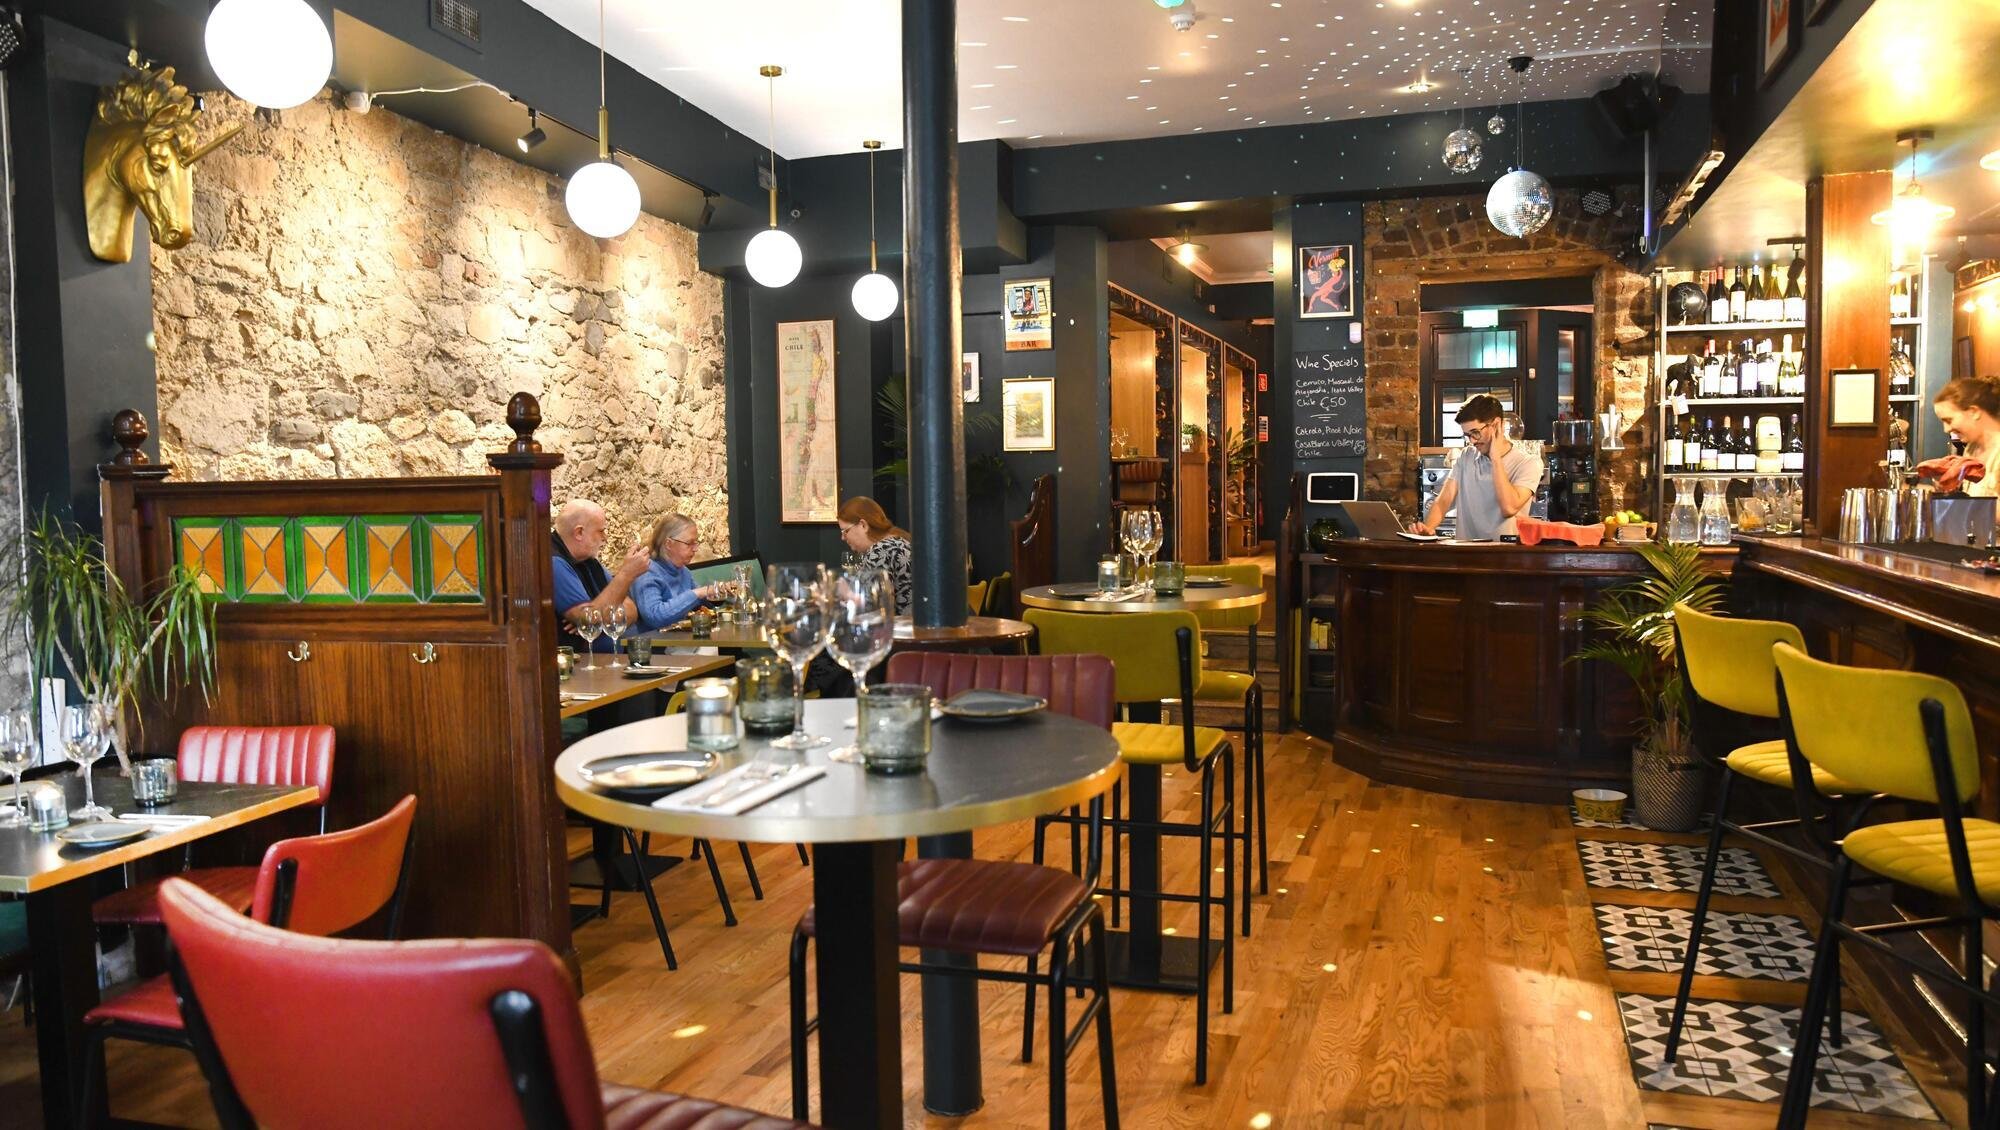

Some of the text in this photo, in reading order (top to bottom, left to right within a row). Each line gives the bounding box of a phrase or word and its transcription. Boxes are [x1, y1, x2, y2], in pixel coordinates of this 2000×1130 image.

[1296, 354, 1359, 371] Wine Specials
[1297, 396, 1346, 411] Chile €50
[1325, 426, 1341, 434] Pinot
